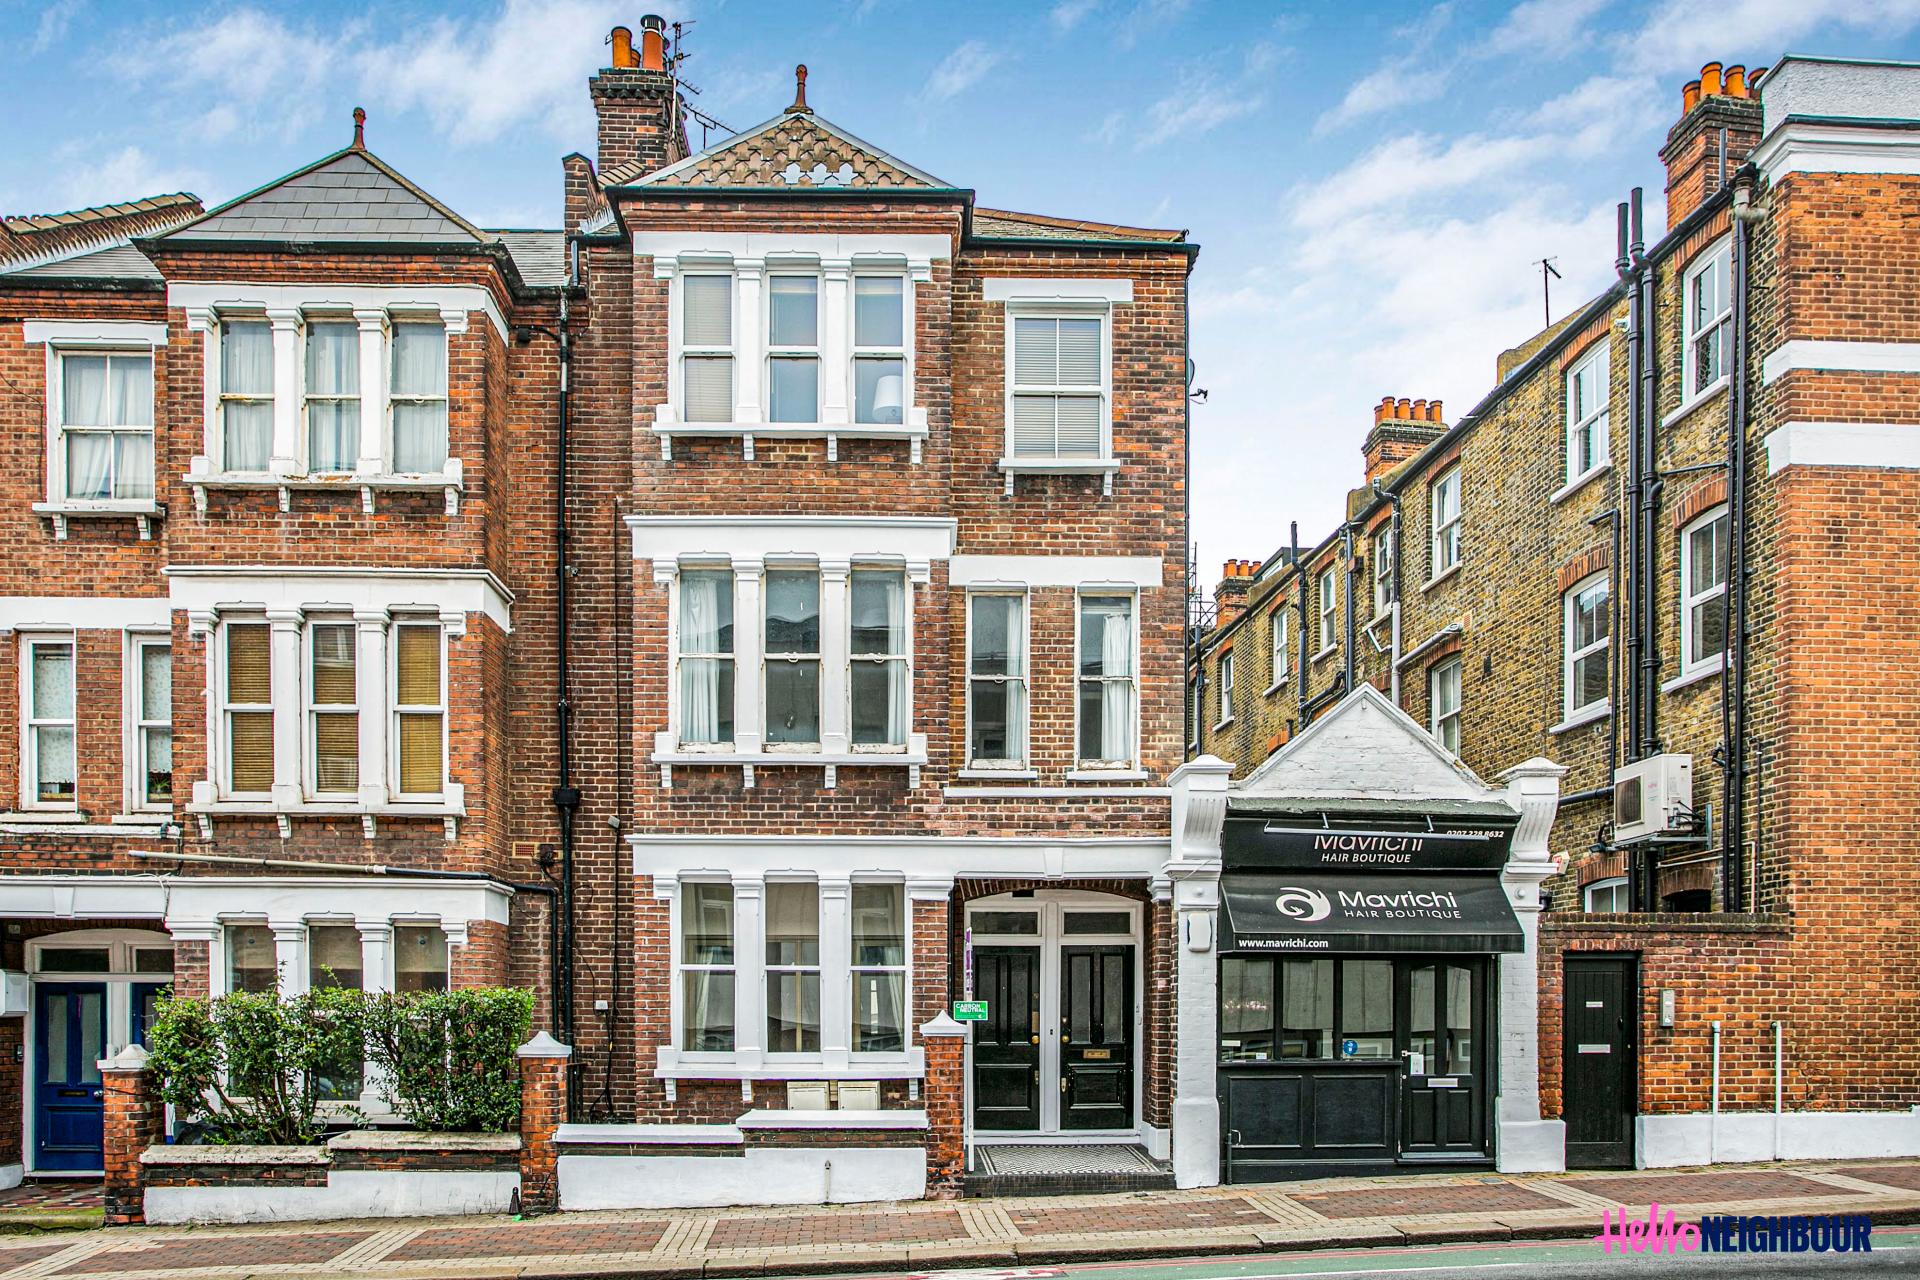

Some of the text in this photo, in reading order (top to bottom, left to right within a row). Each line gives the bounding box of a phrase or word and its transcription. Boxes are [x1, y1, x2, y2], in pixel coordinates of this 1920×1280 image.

[1321, 853, 1412, 864] HAIR BOUTIQUE
[1337, 890, 1458, 908] Mavrichi
[1344, 909, 1462, 919] HAIR BOUTIQUE
[1238, 938, 1329, 948] www.mavrichi.com
